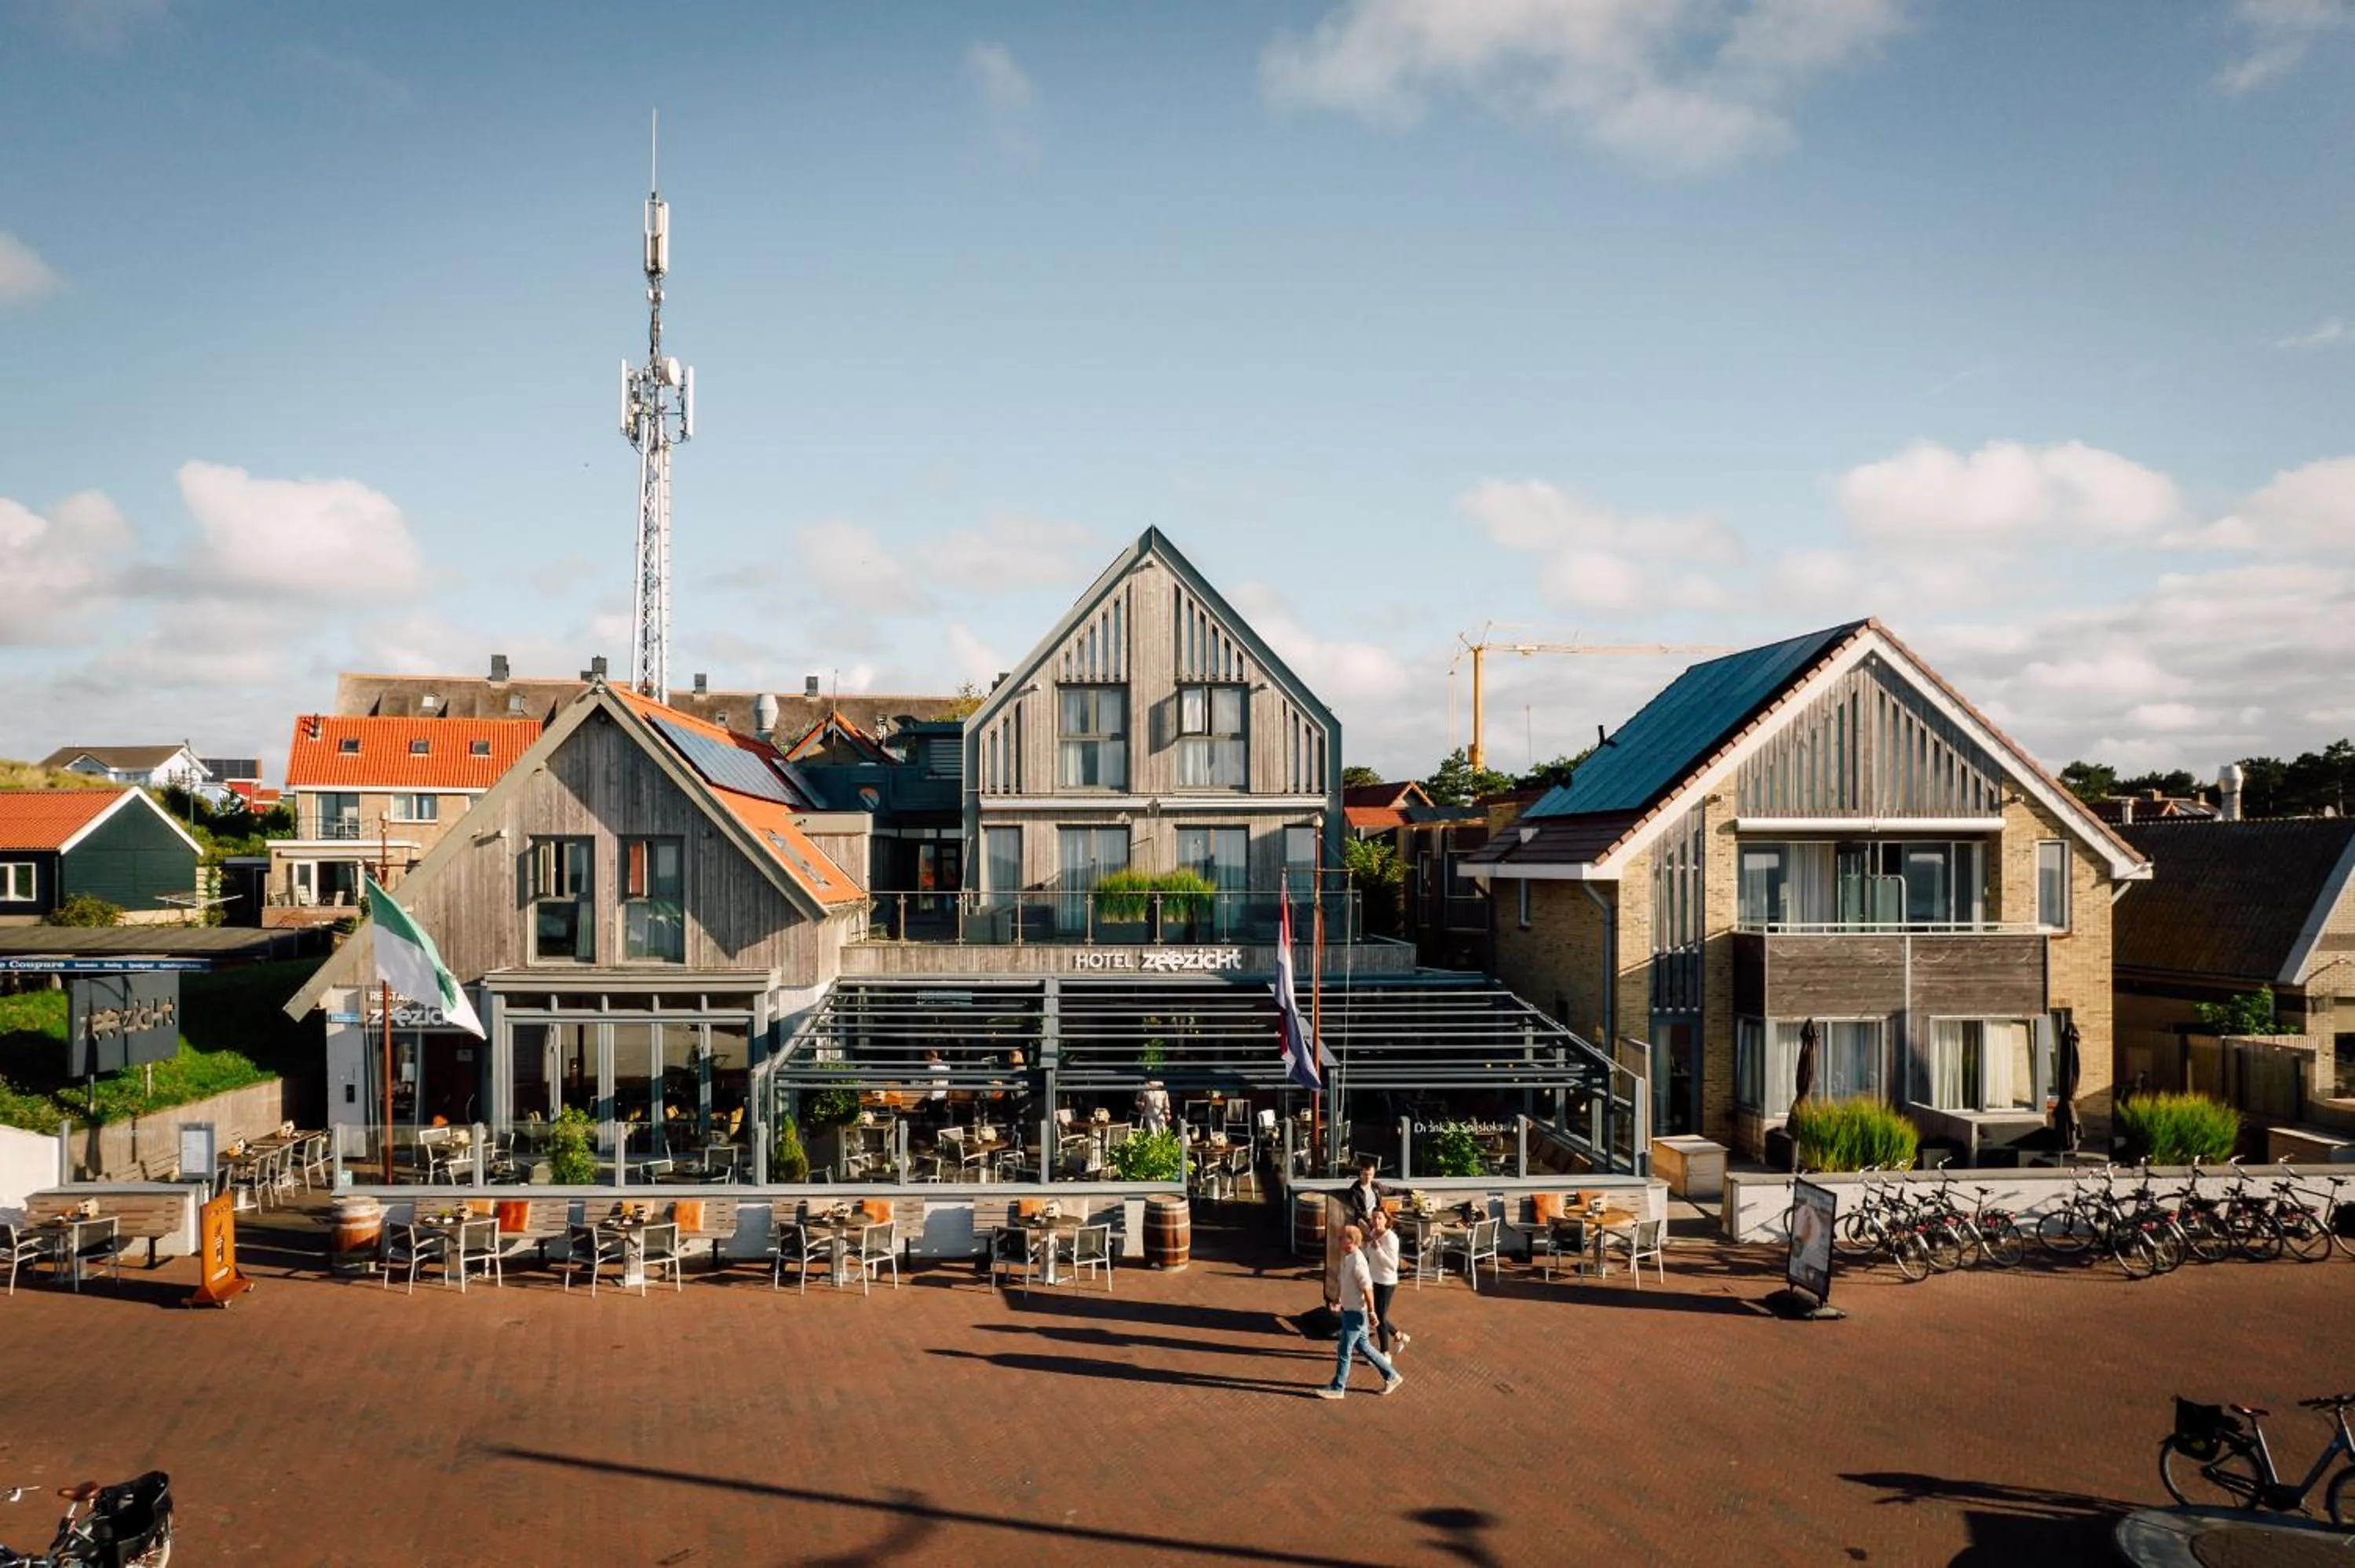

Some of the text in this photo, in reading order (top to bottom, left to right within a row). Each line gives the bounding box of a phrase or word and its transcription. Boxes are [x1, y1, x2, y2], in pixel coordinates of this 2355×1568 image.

[9, 960, 65, 969] Coupure
[1076, 948, 1241, 971] HOTEL zeezicht
[78, 996, 176, 1041] zeezicht
